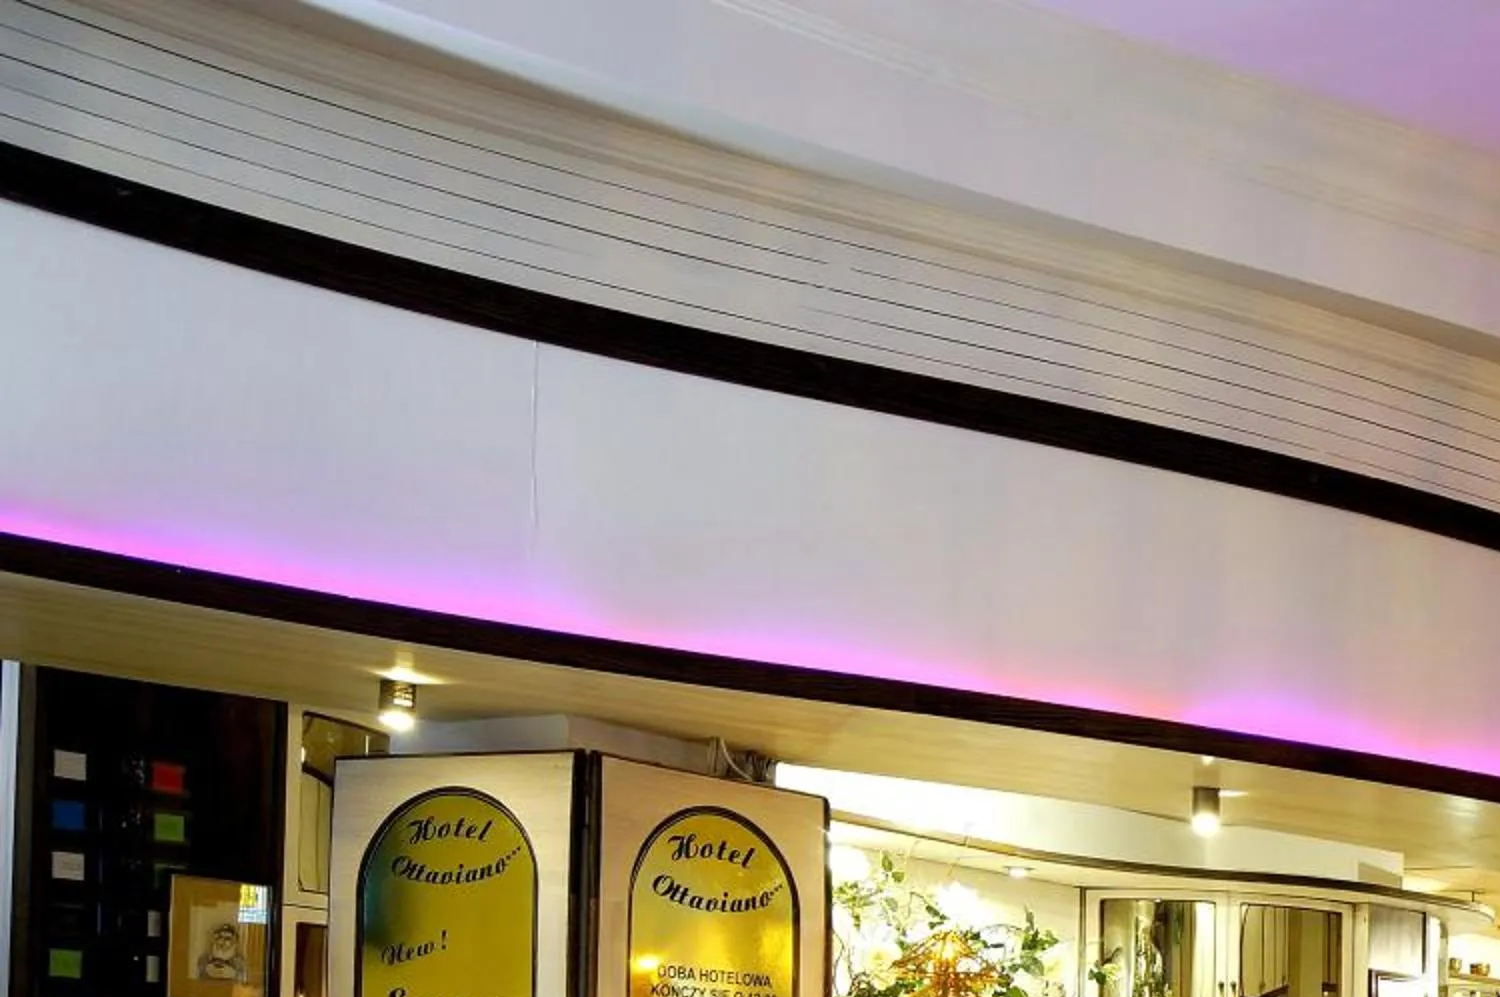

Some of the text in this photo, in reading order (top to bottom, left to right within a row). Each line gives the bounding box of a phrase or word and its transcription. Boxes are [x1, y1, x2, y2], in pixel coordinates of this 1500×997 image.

[408, 815, 492, 845] Hotel
[667, 833, 756, 869] Hotel
[391, 855, 509, 885] Ottaviano
[652, 873, 772, 913] Ottaviano
[699, 970, 773, 989] HOTELOWA
